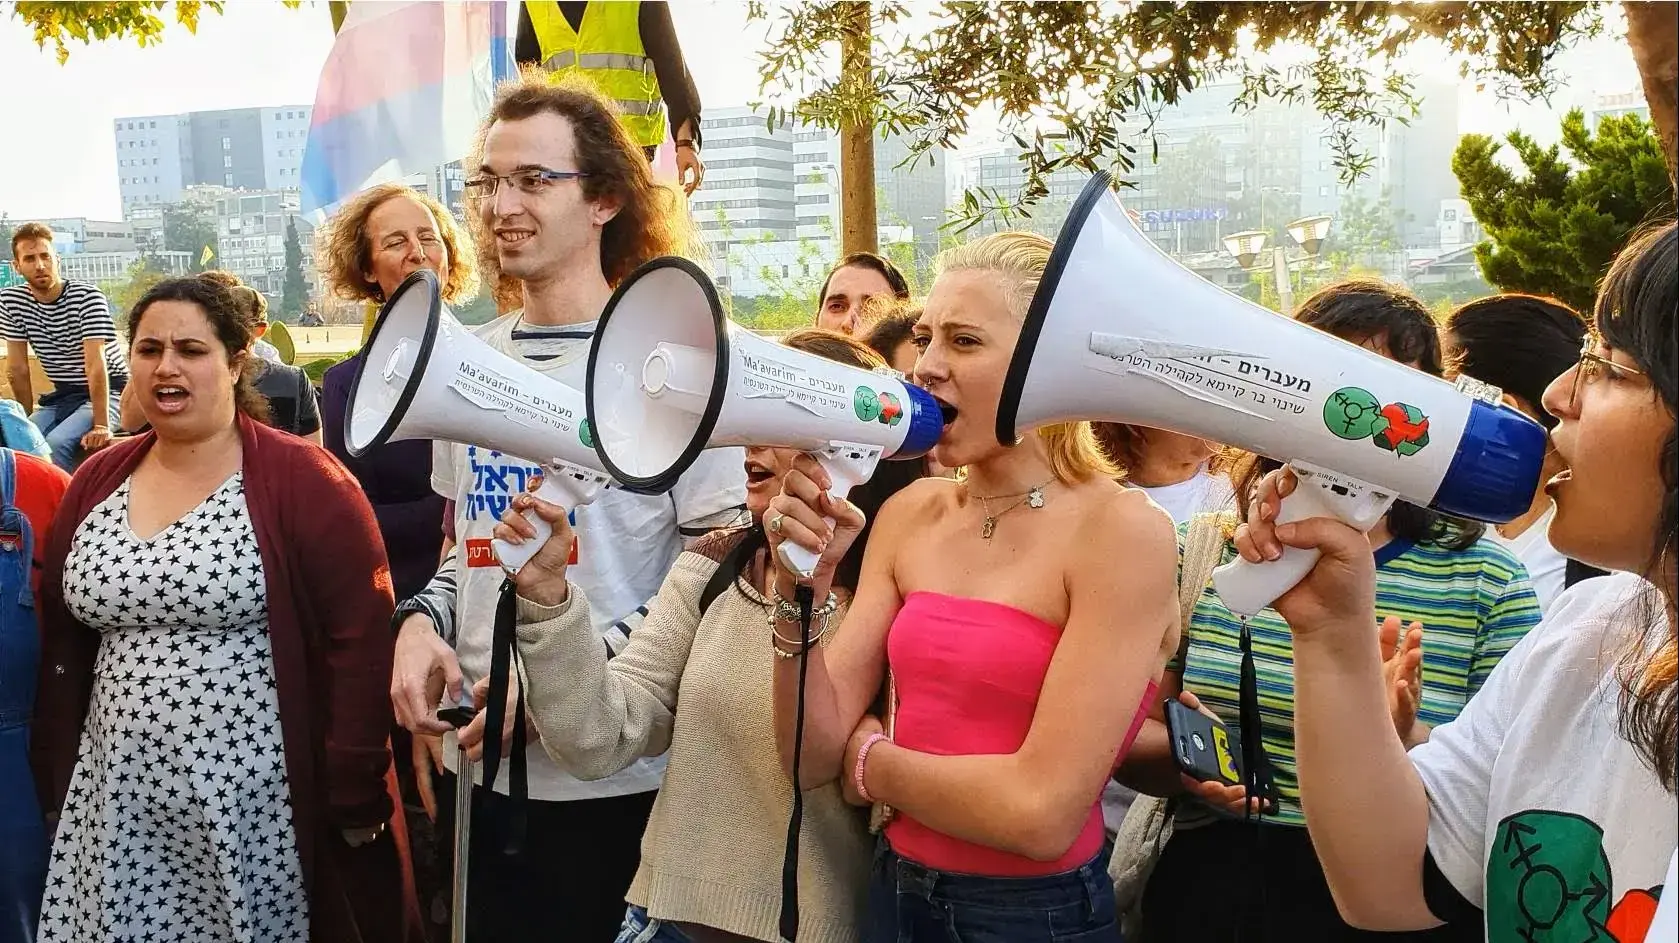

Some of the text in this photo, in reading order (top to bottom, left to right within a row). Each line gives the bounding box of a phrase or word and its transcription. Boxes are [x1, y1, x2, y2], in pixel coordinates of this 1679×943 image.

[743, 356, 796, 382] Ma'avarim
[1155, 361, 1203, 384] לקהילה
[1237, 359, 1312, 393] מעברים
[459, 361, 519, 397] Ma'avarim
[808, 376, 846, 394] מעברים
[1206, 378, 1246, 398] קיימא
[486, 393, 514, 408] לקהילה
[796, 392, 817, 404] קיימא
[818, 397, 827, 406] בר
[828, 400, 846, 410] שינוי
[1250, 390, 1266, 404] בר
[1272, 396, 1305, 414] שינוי
[514, 404, 538, 420] קיימא
[532, 395, 573, 418] מעברים
[540, 415, 549, 424] בר
[551, 419, 570, 432] שינוי
[1316, 472, 1364, 492] SIREN TALK
